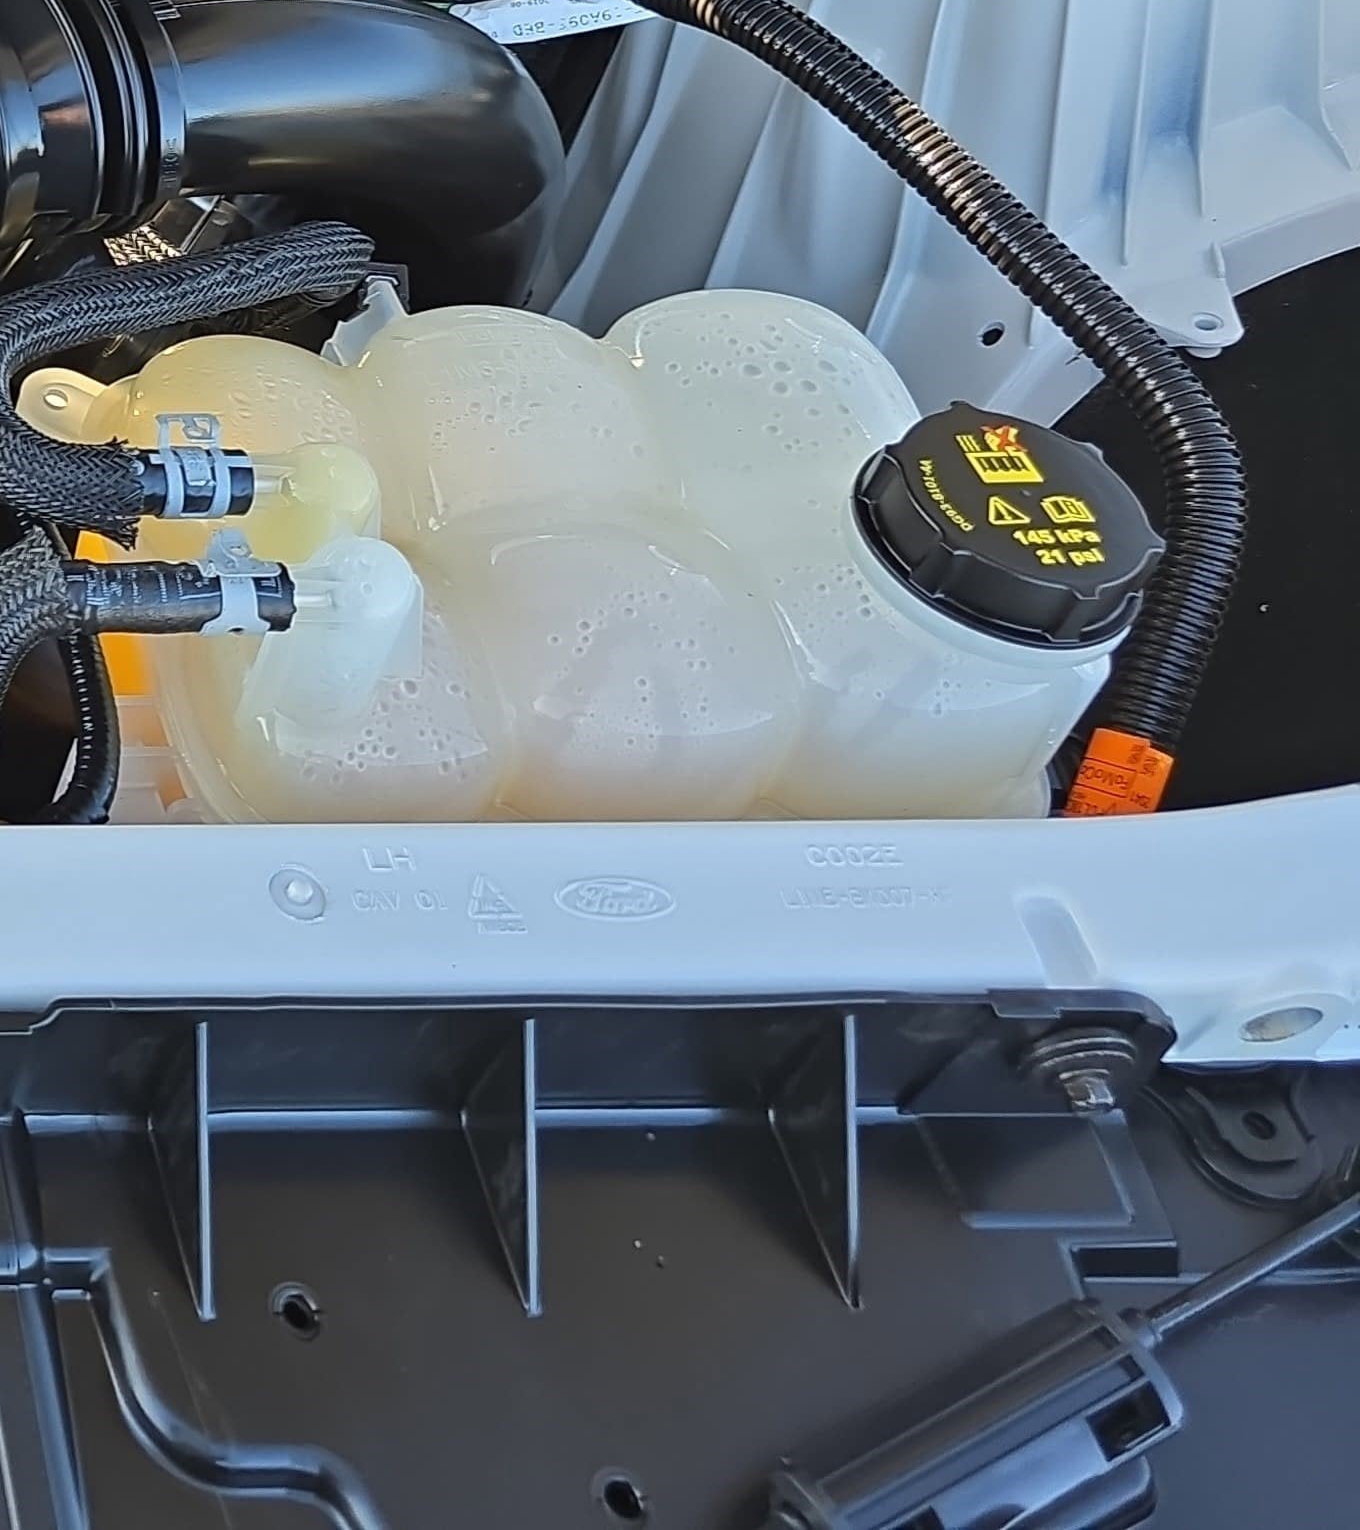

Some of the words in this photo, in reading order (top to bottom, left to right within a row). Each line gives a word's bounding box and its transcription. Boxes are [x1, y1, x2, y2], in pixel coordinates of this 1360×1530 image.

[1013, 529, 1056, 546] 145
[1058, 528, 1100, 544] kPa
[1036, 549, 1066, 565] 21
[1070, 549, 1105, 567] psi
[362, 846, 418, 871] LH
[574, 883, 657, 914] Ford
